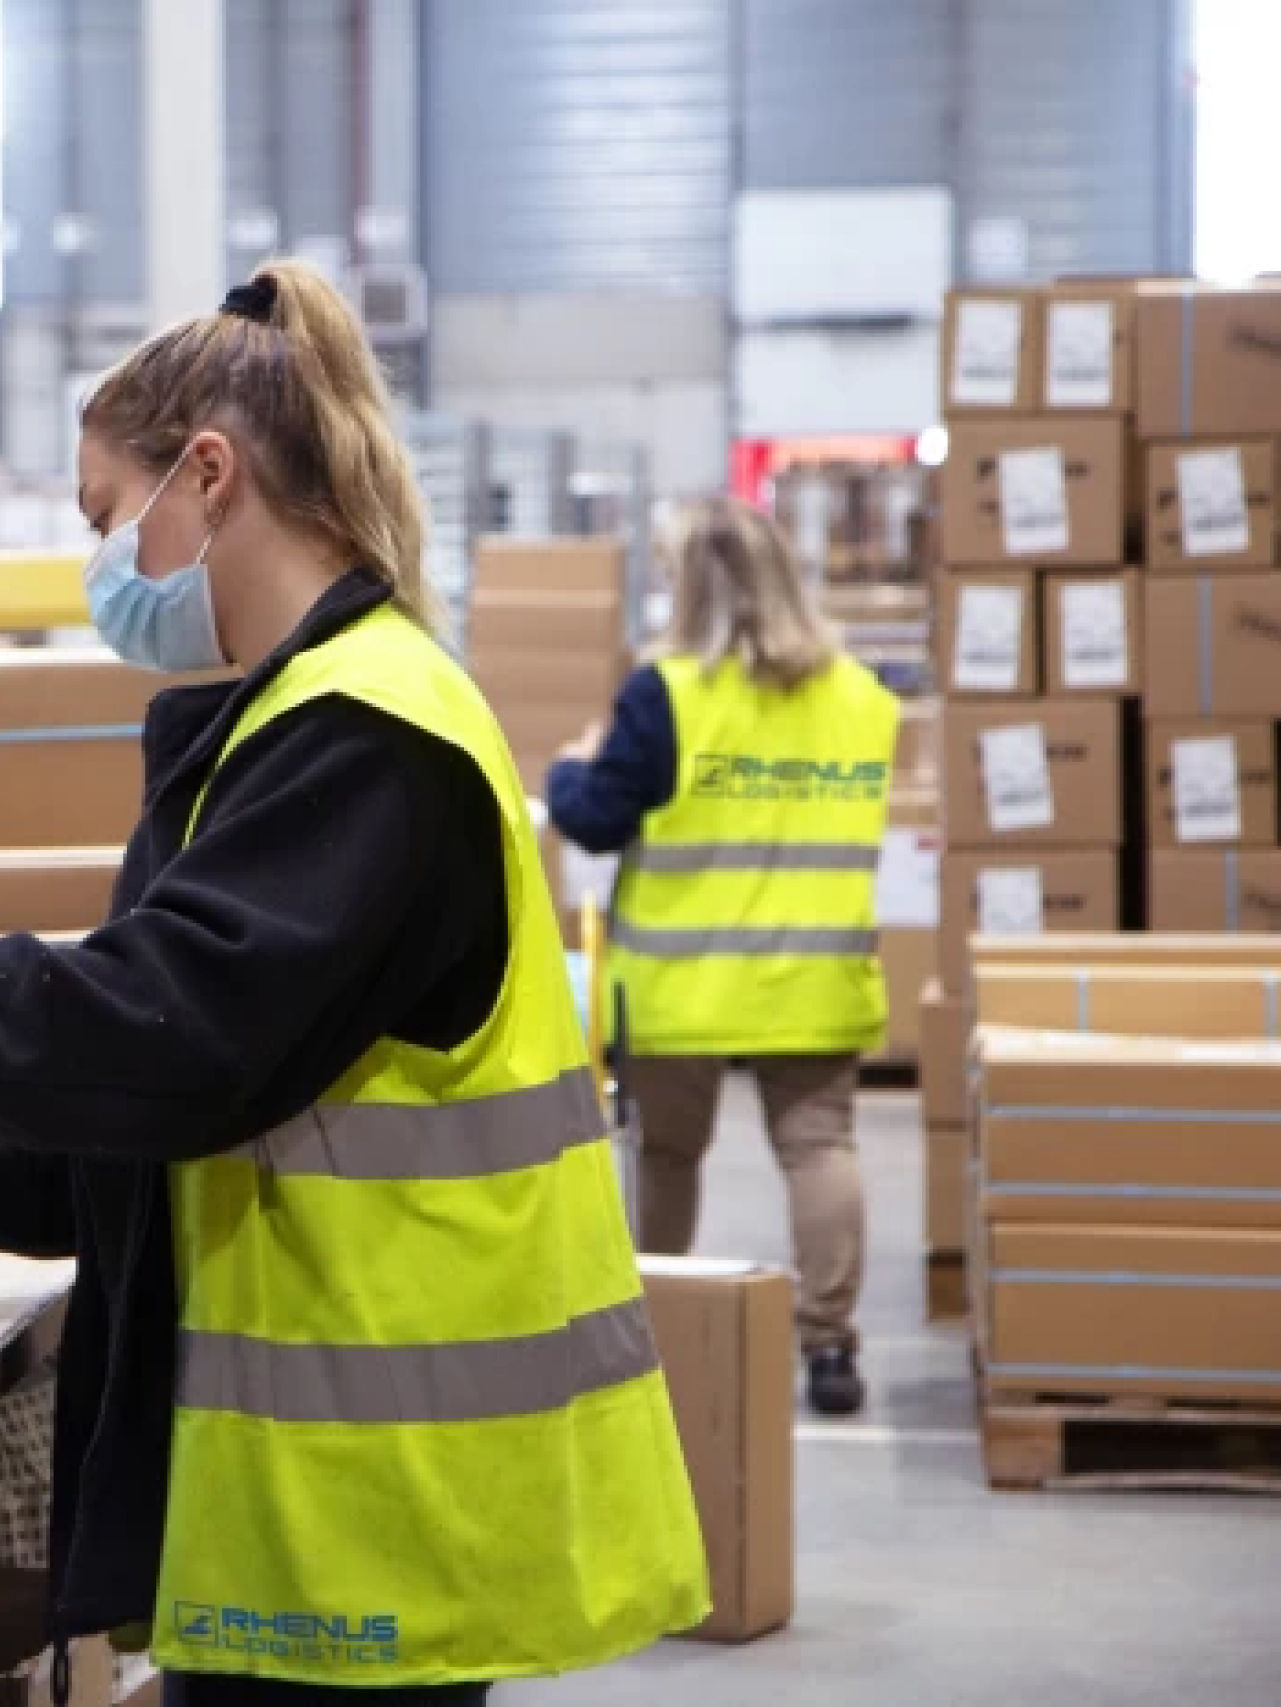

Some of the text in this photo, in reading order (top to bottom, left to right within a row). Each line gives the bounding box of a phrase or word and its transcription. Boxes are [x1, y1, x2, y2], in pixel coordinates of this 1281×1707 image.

[730, 756, 887, 782] RHENUS
[221, 1607, 398, 1642] RHENUS
[223, 1636, 398, 1662] LOGISTICS
